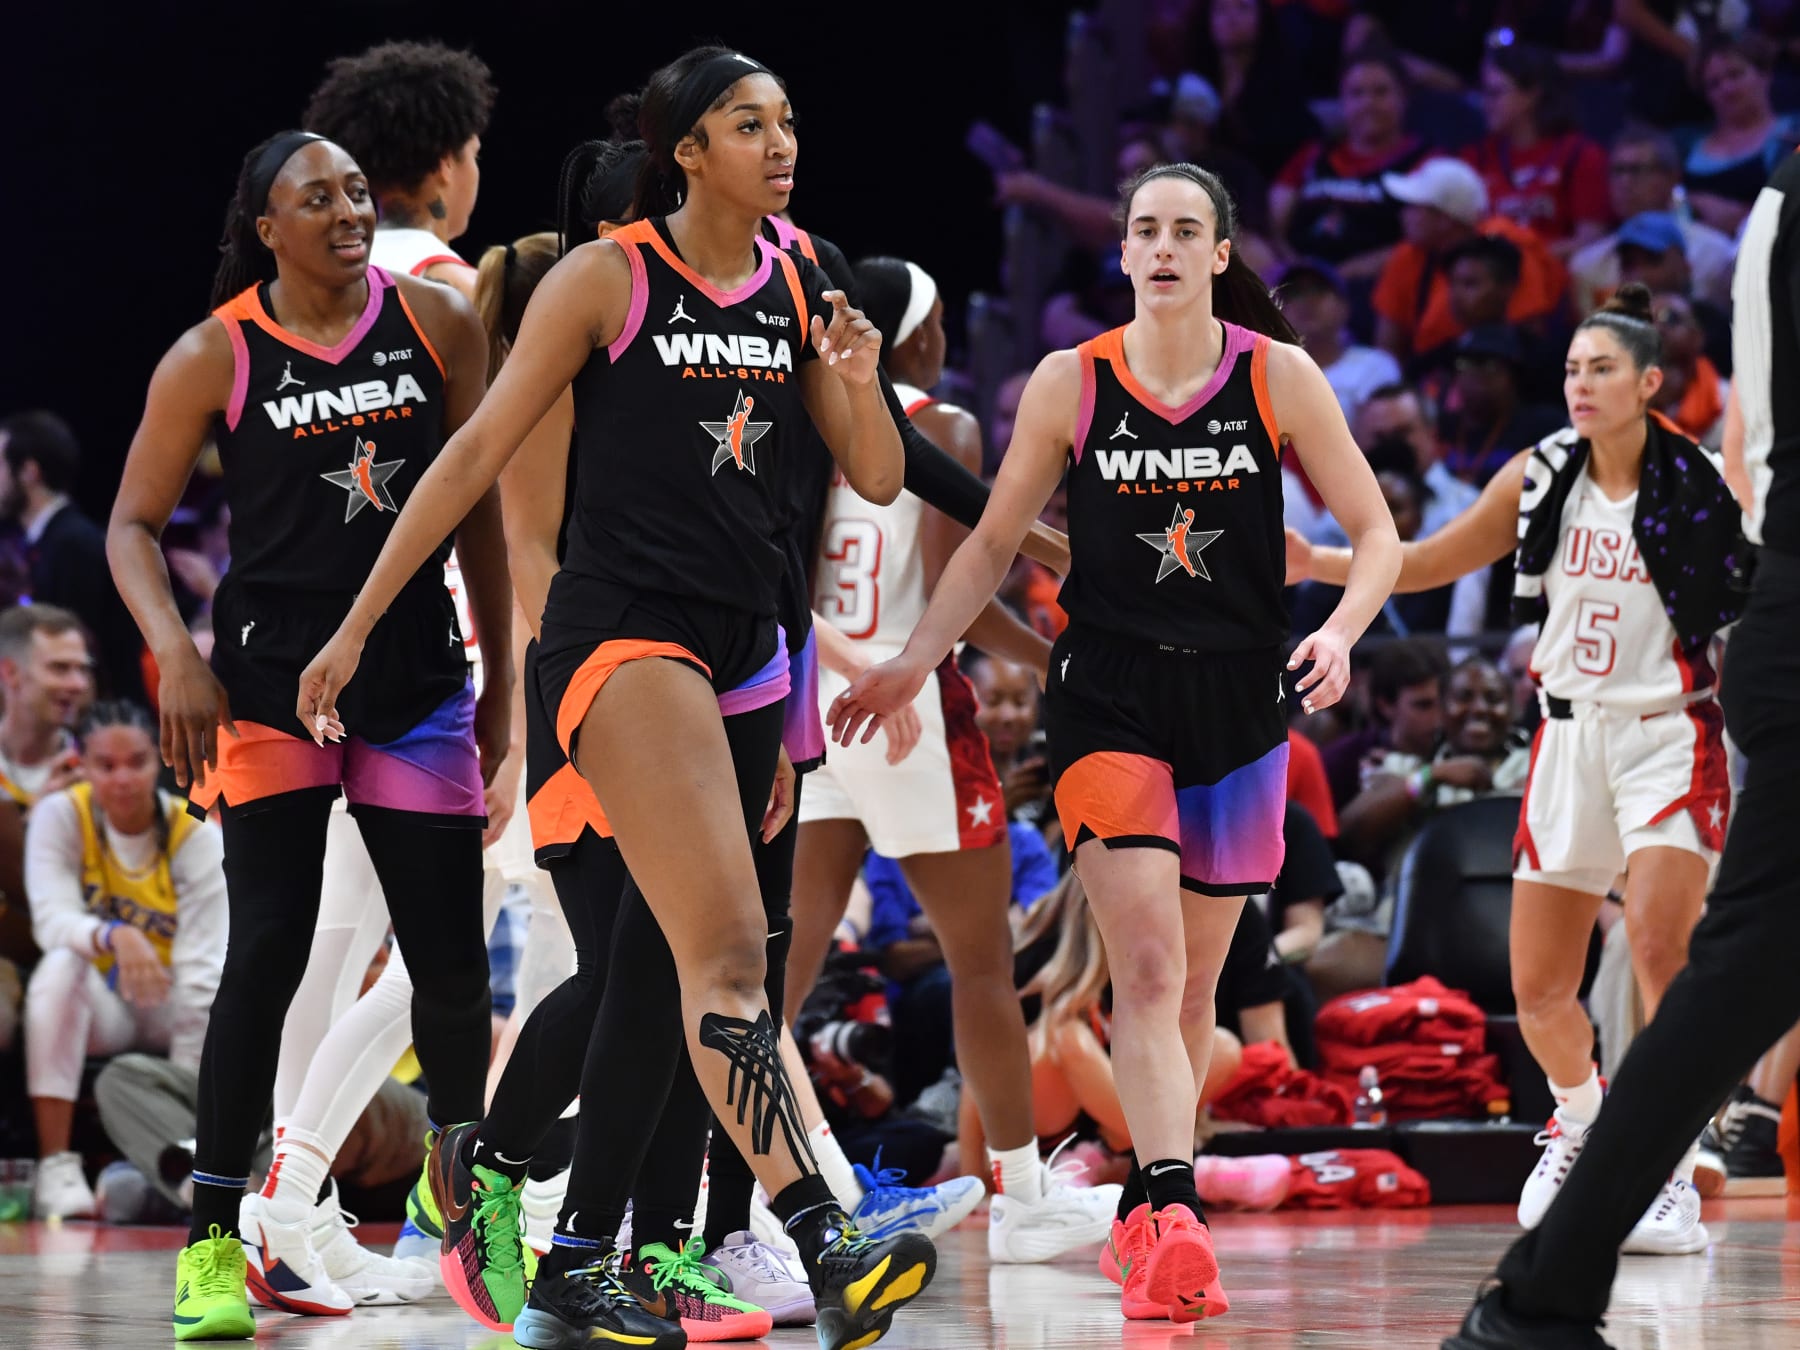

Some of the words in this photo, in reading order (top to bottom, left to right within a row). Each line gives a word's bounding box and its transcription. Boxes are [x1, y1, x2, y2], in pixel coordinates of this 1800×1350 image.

[768, 315, 791, 327] AT&T
[388, 348, 413, 362] AT&T
[651, 333, 793, 373] WNBA
[682, 366, 785, 384] ALL-STAR
[262, 373, 428, 430] WNBA
[293, 406, 413, 439] ALL-STAR
[1223, 419, 1248, 432] AT&T
[1094, 444, 1260, 481] WNBA
[1116, 478, 1241, 495] ALL-STAR
[1562, 527, 1652, 583] USA
[1573, 598, 1620, 677] 5
